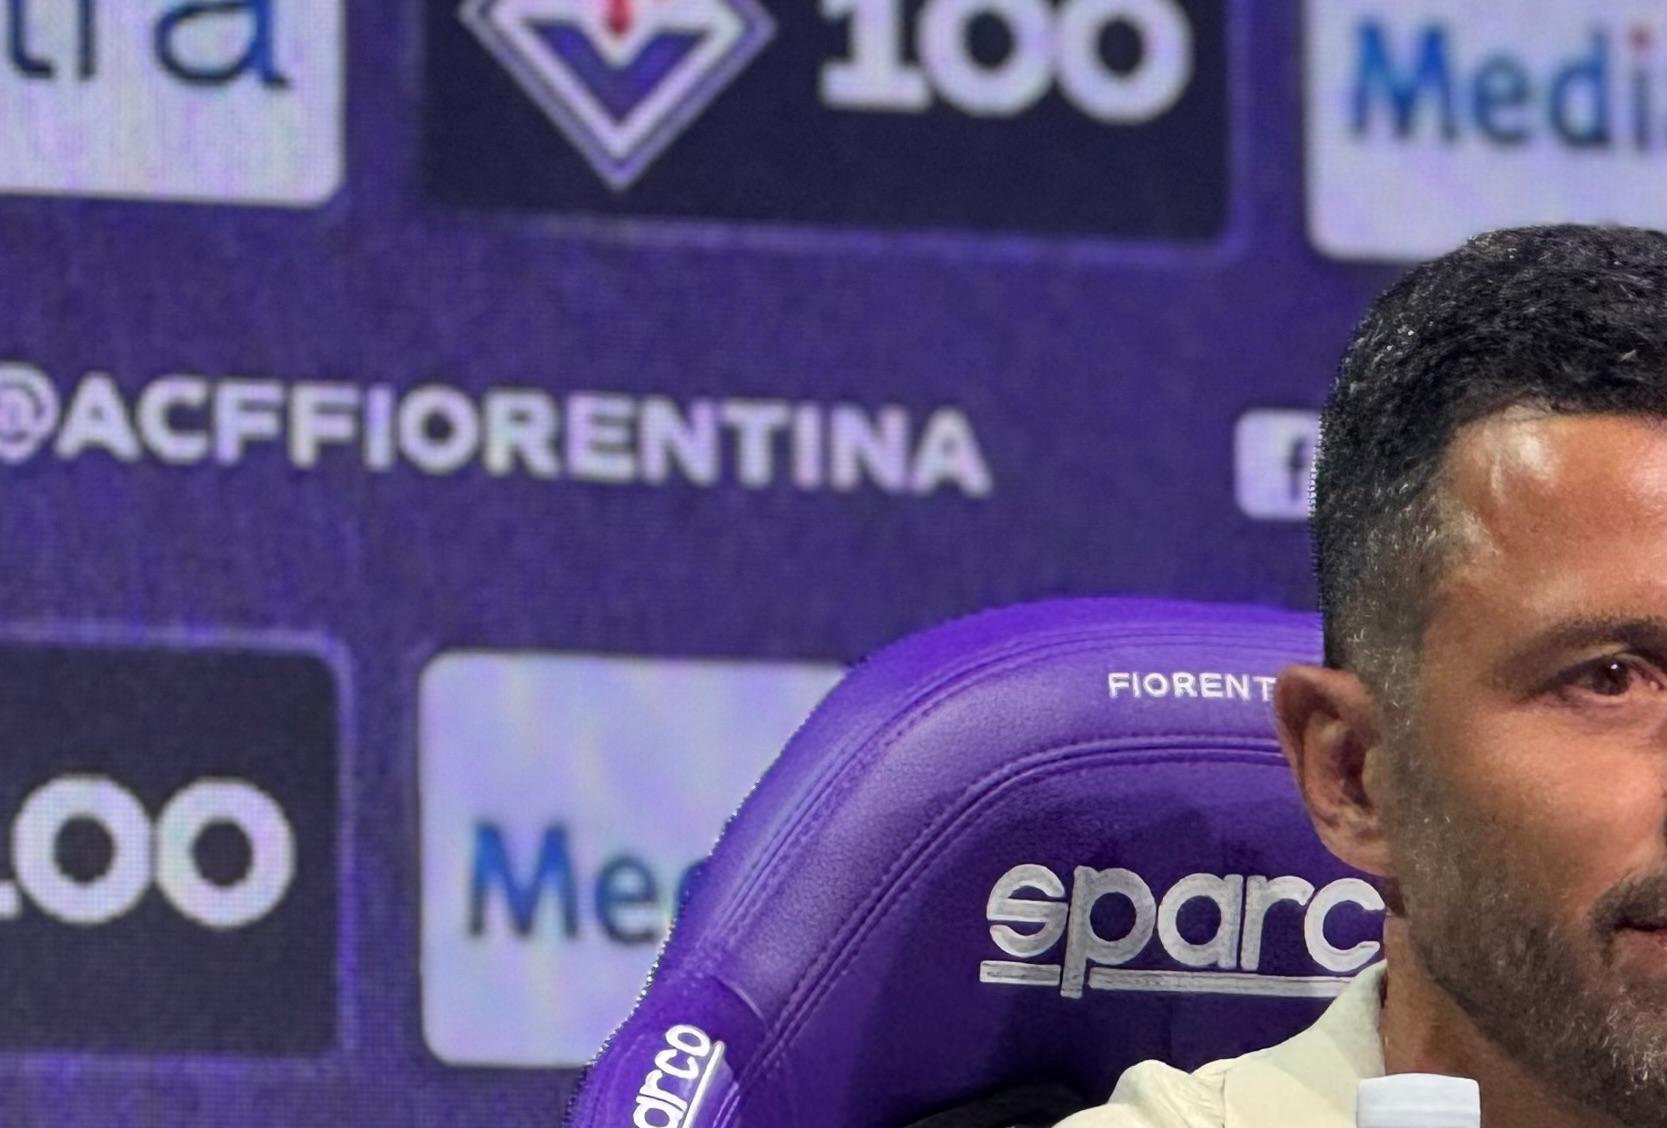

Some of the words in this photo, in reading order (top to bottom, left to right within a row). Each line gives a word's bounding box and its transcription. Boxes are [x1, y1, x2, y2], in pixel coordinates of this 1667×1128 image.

[819, 0, 1193, 122] 100
[0, 362, 991, 496] @ACFFIORENTINA
[1107, 671, 1277, 702] FIORENT
[0, 774, 296, 929] 00
[982, 863, 1386, 999] sparc
